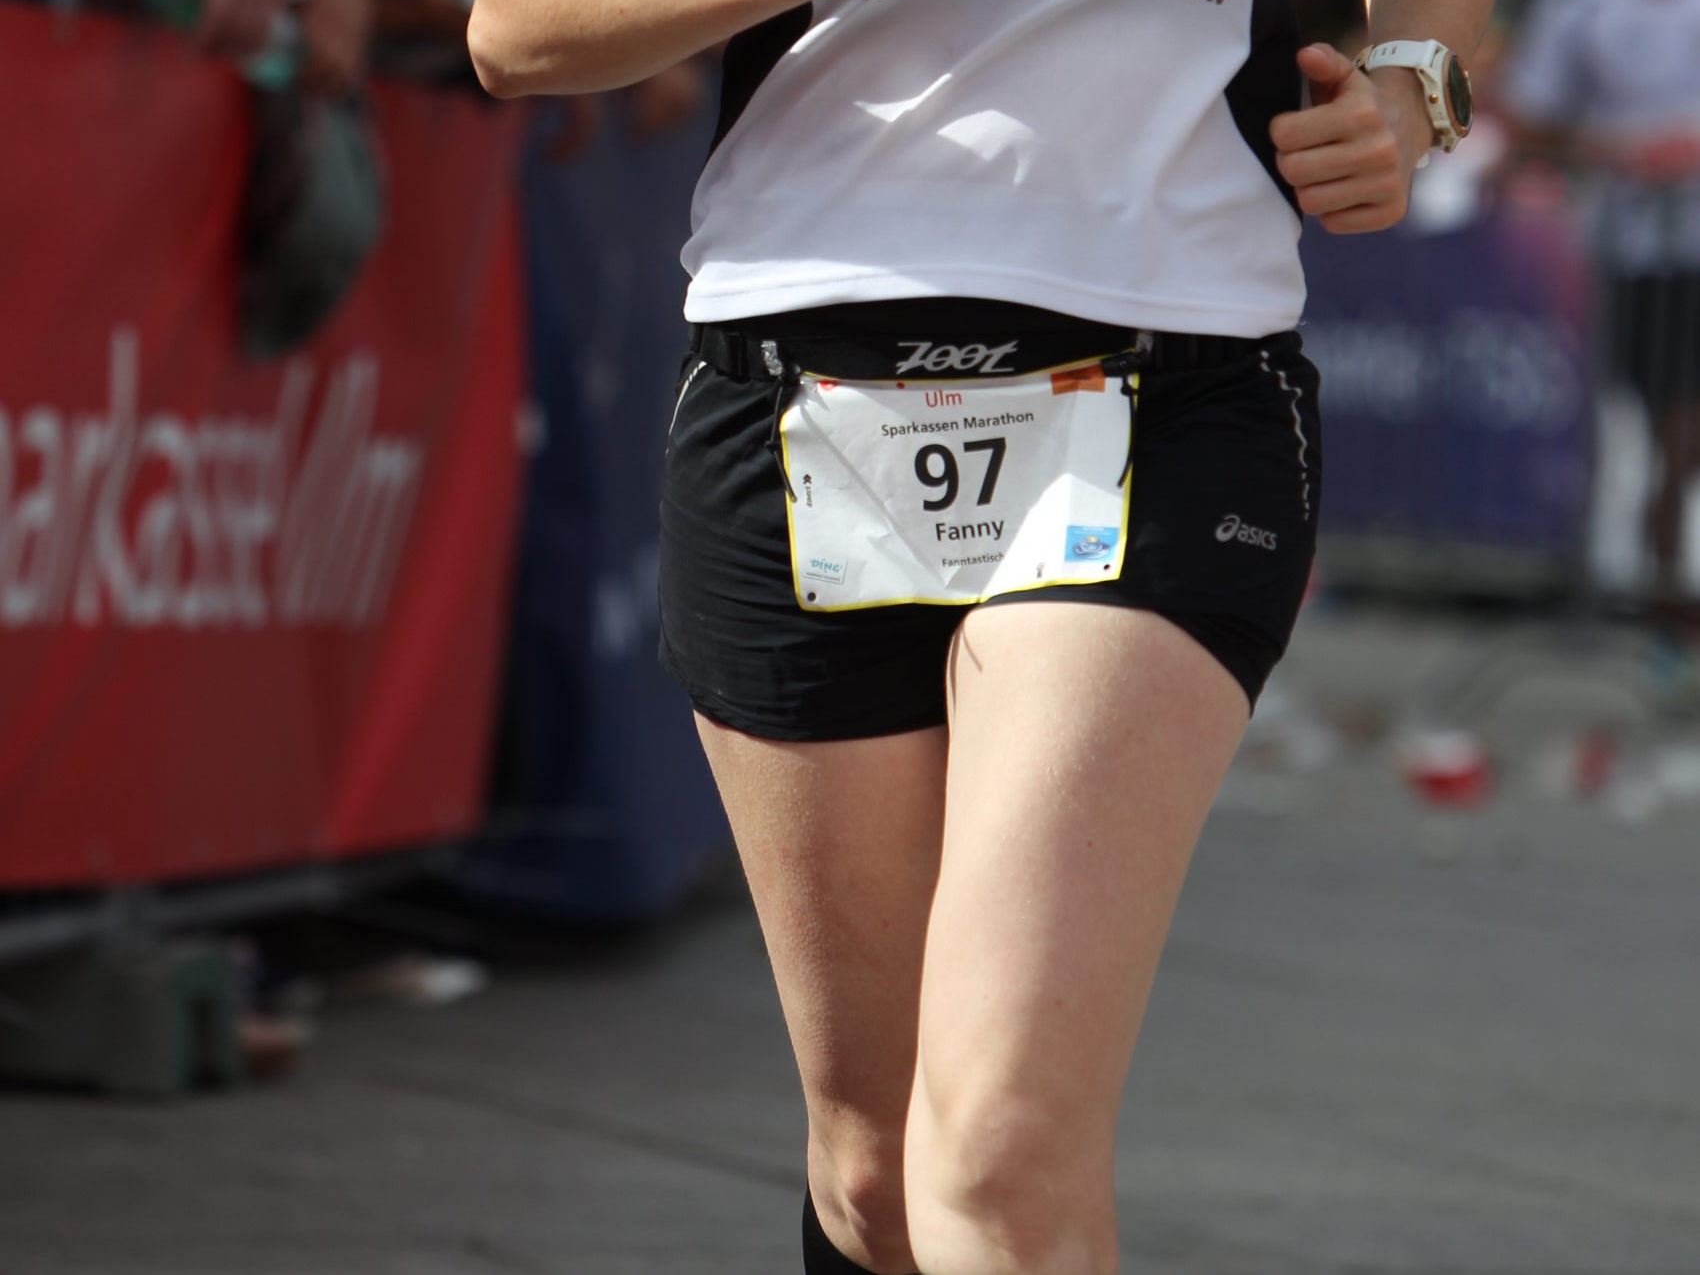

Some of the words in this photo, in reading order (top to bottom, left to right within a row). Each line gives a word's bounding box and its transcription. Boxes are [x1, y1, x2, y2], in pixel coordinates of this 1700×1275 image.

[924, 389, 963, 408] Ulm
[881, 417, 960, 438] Sparkassen
[963, 410, 1035, 429] Marathon
[913, 436, 1008, 513] 97
[935, 518, 1005, 542] Fanny
